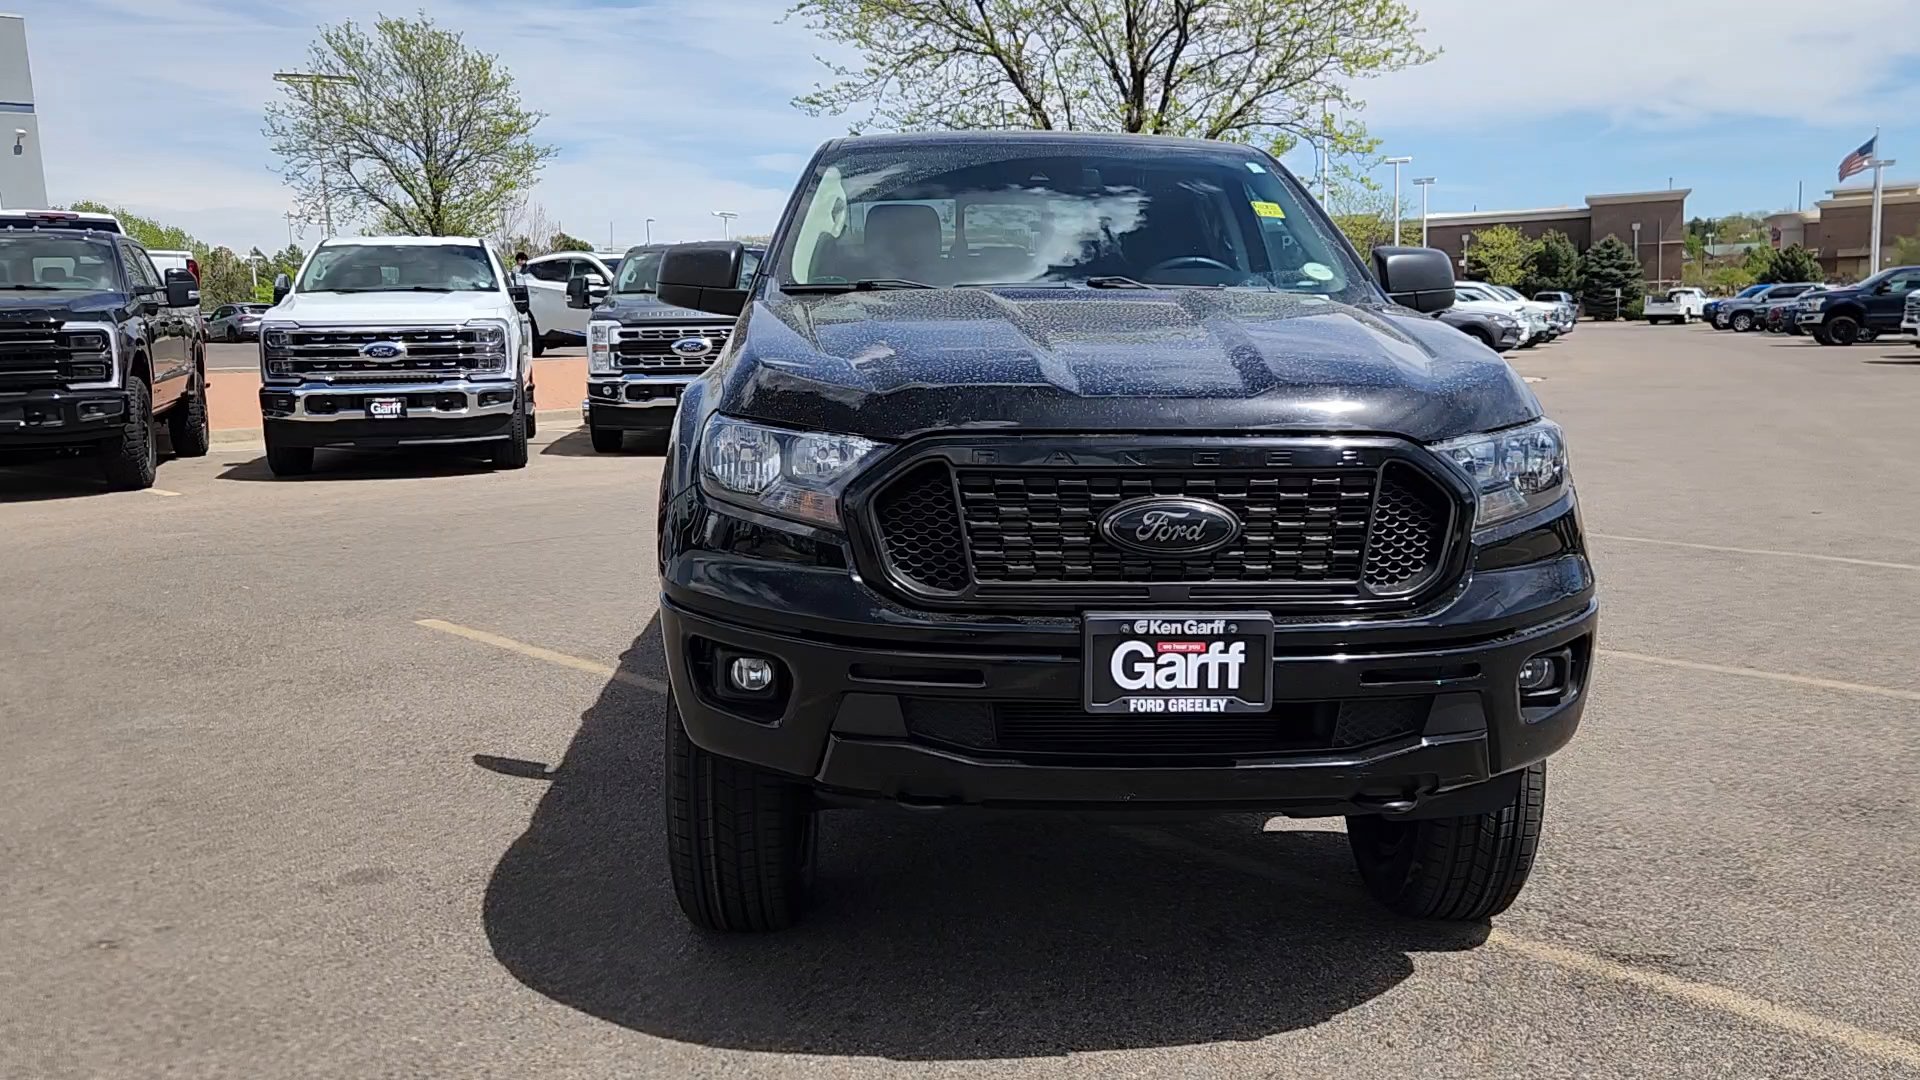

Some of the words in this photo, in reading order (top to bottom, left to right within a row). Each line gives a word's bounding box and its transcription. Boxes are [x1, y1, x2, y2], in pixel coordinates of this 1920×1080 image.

[371, 347, 395, 356] Ford
[370, 402, 401, 414] Garff
[971, 449, 1363, 466] RANGER
[1136, 511, 1207, 541] Ford
[1150, 620, 1182, 634] Ken
[1183, 620, 1226, 634] Garff
[1111, 640, 1245, 690] Garff
[1130, 699, 1164, 712] FORD
[1168, 699, 1227, 712] GREELEY
